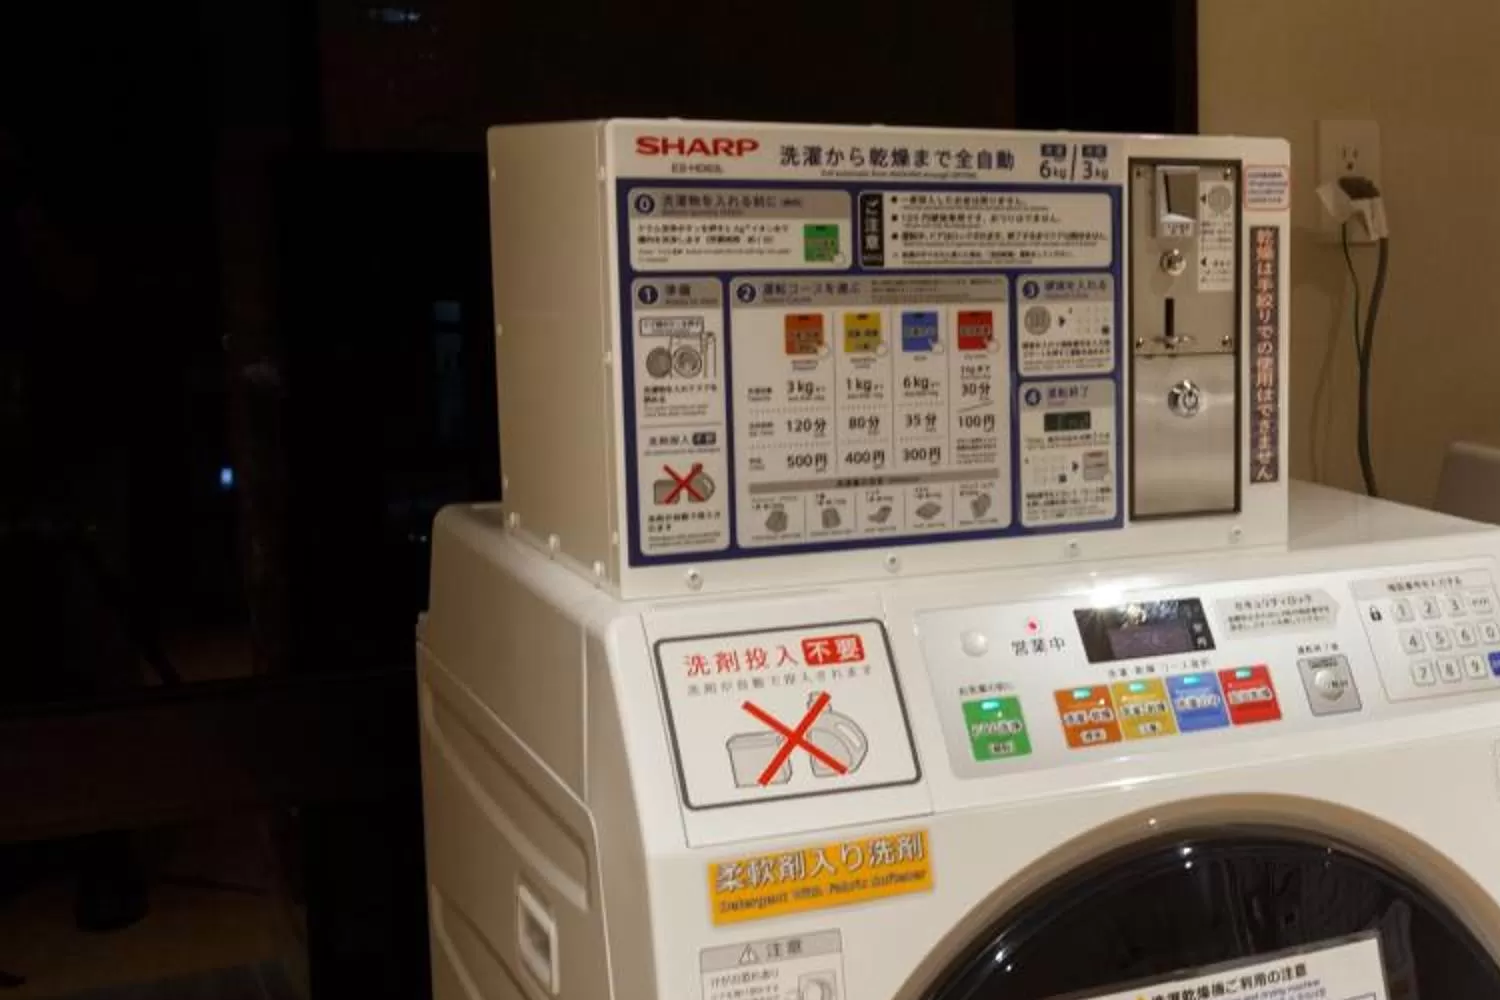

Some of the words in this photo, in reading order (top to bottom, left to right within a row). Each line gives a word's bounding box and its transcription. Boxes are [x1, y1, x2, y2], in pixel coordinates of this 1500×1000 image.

[636, 136, 759, 157] SHARP
[780, 144, 1014, 171] 洗濯から乾燥まで全自動
[787, 417, 826, 432] 120分
[849, 416, 880, 431] 80分
[959, 414, 995, 429] 100円
[787, 452, 827, 468] 500円
[845, 450, 884, 465] 400円
[903, 447, 940, 463] 300円
[1011, 635, 1066, 656] 営業中
[685, 645, 799, 677] 洗剤投入
[806, 637, 862, 665] 不要
[717, 832, 925, 893] 柔軟剤入り洗剤
